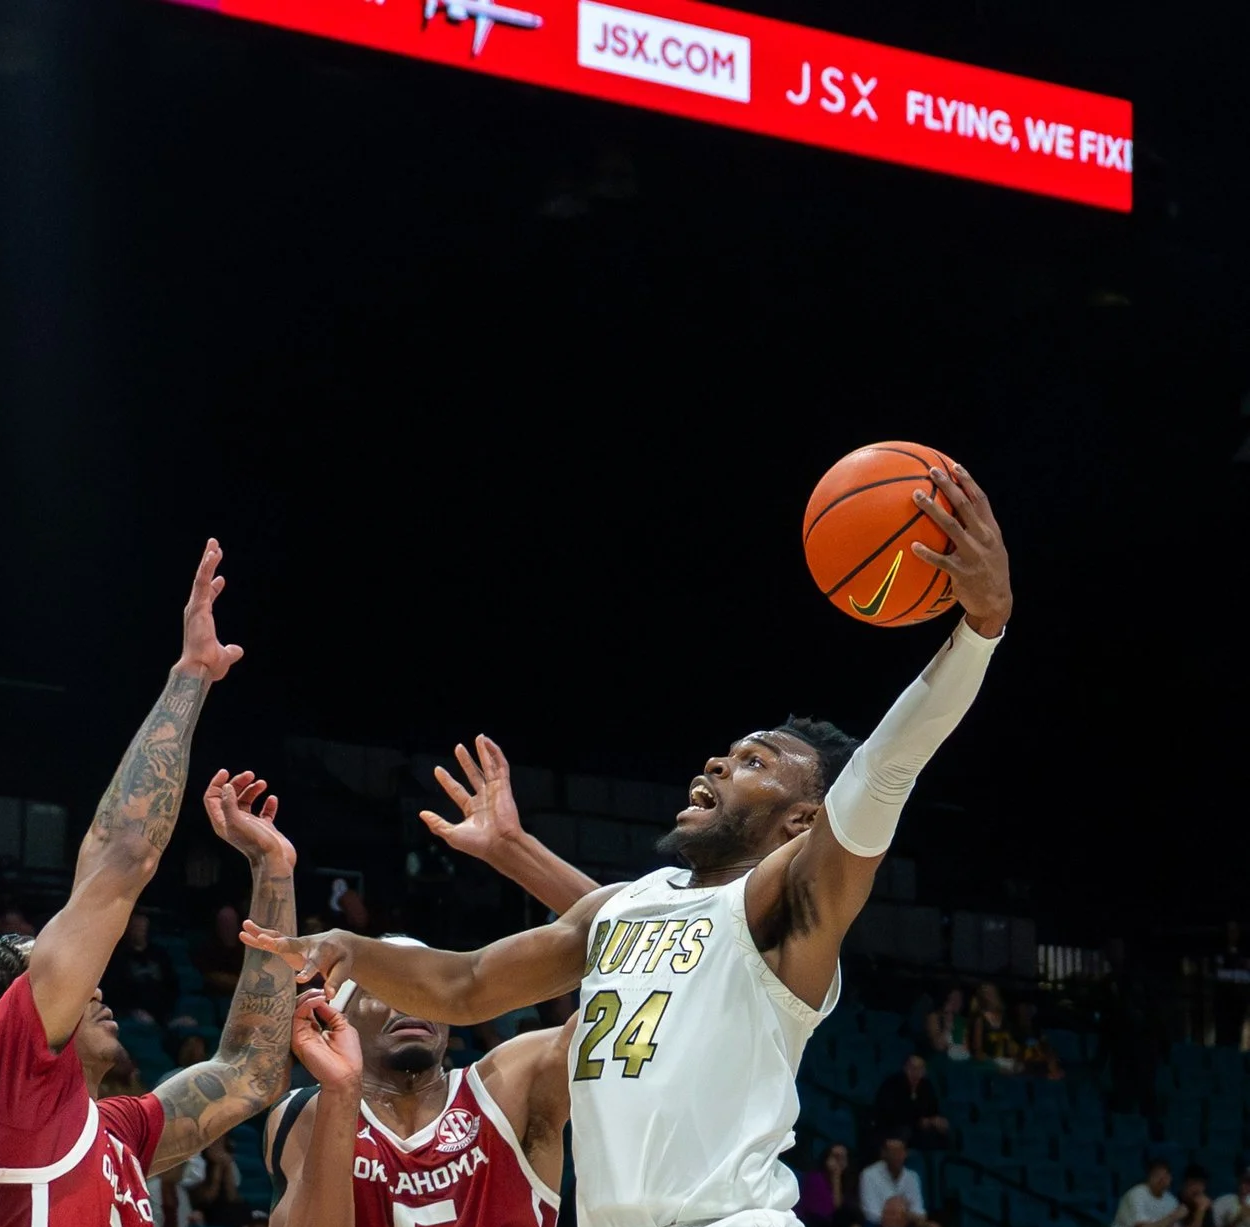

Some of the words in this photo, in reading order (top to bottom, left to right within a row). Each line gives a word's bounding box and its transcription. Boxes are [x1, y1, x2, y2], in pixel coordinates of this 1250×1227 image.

[593, 21, 736, 82] JSX.COM
[784, 60, 879, 122] JSX
[905, 89, 1020, 152] FLYING,
[1024, 116, 1075, 160] WE
[585, 917, 714, 977] BUFFS
[572, 989, 673, 1082] 24
[353, 1145, 490, 1196] OKAHOMA
